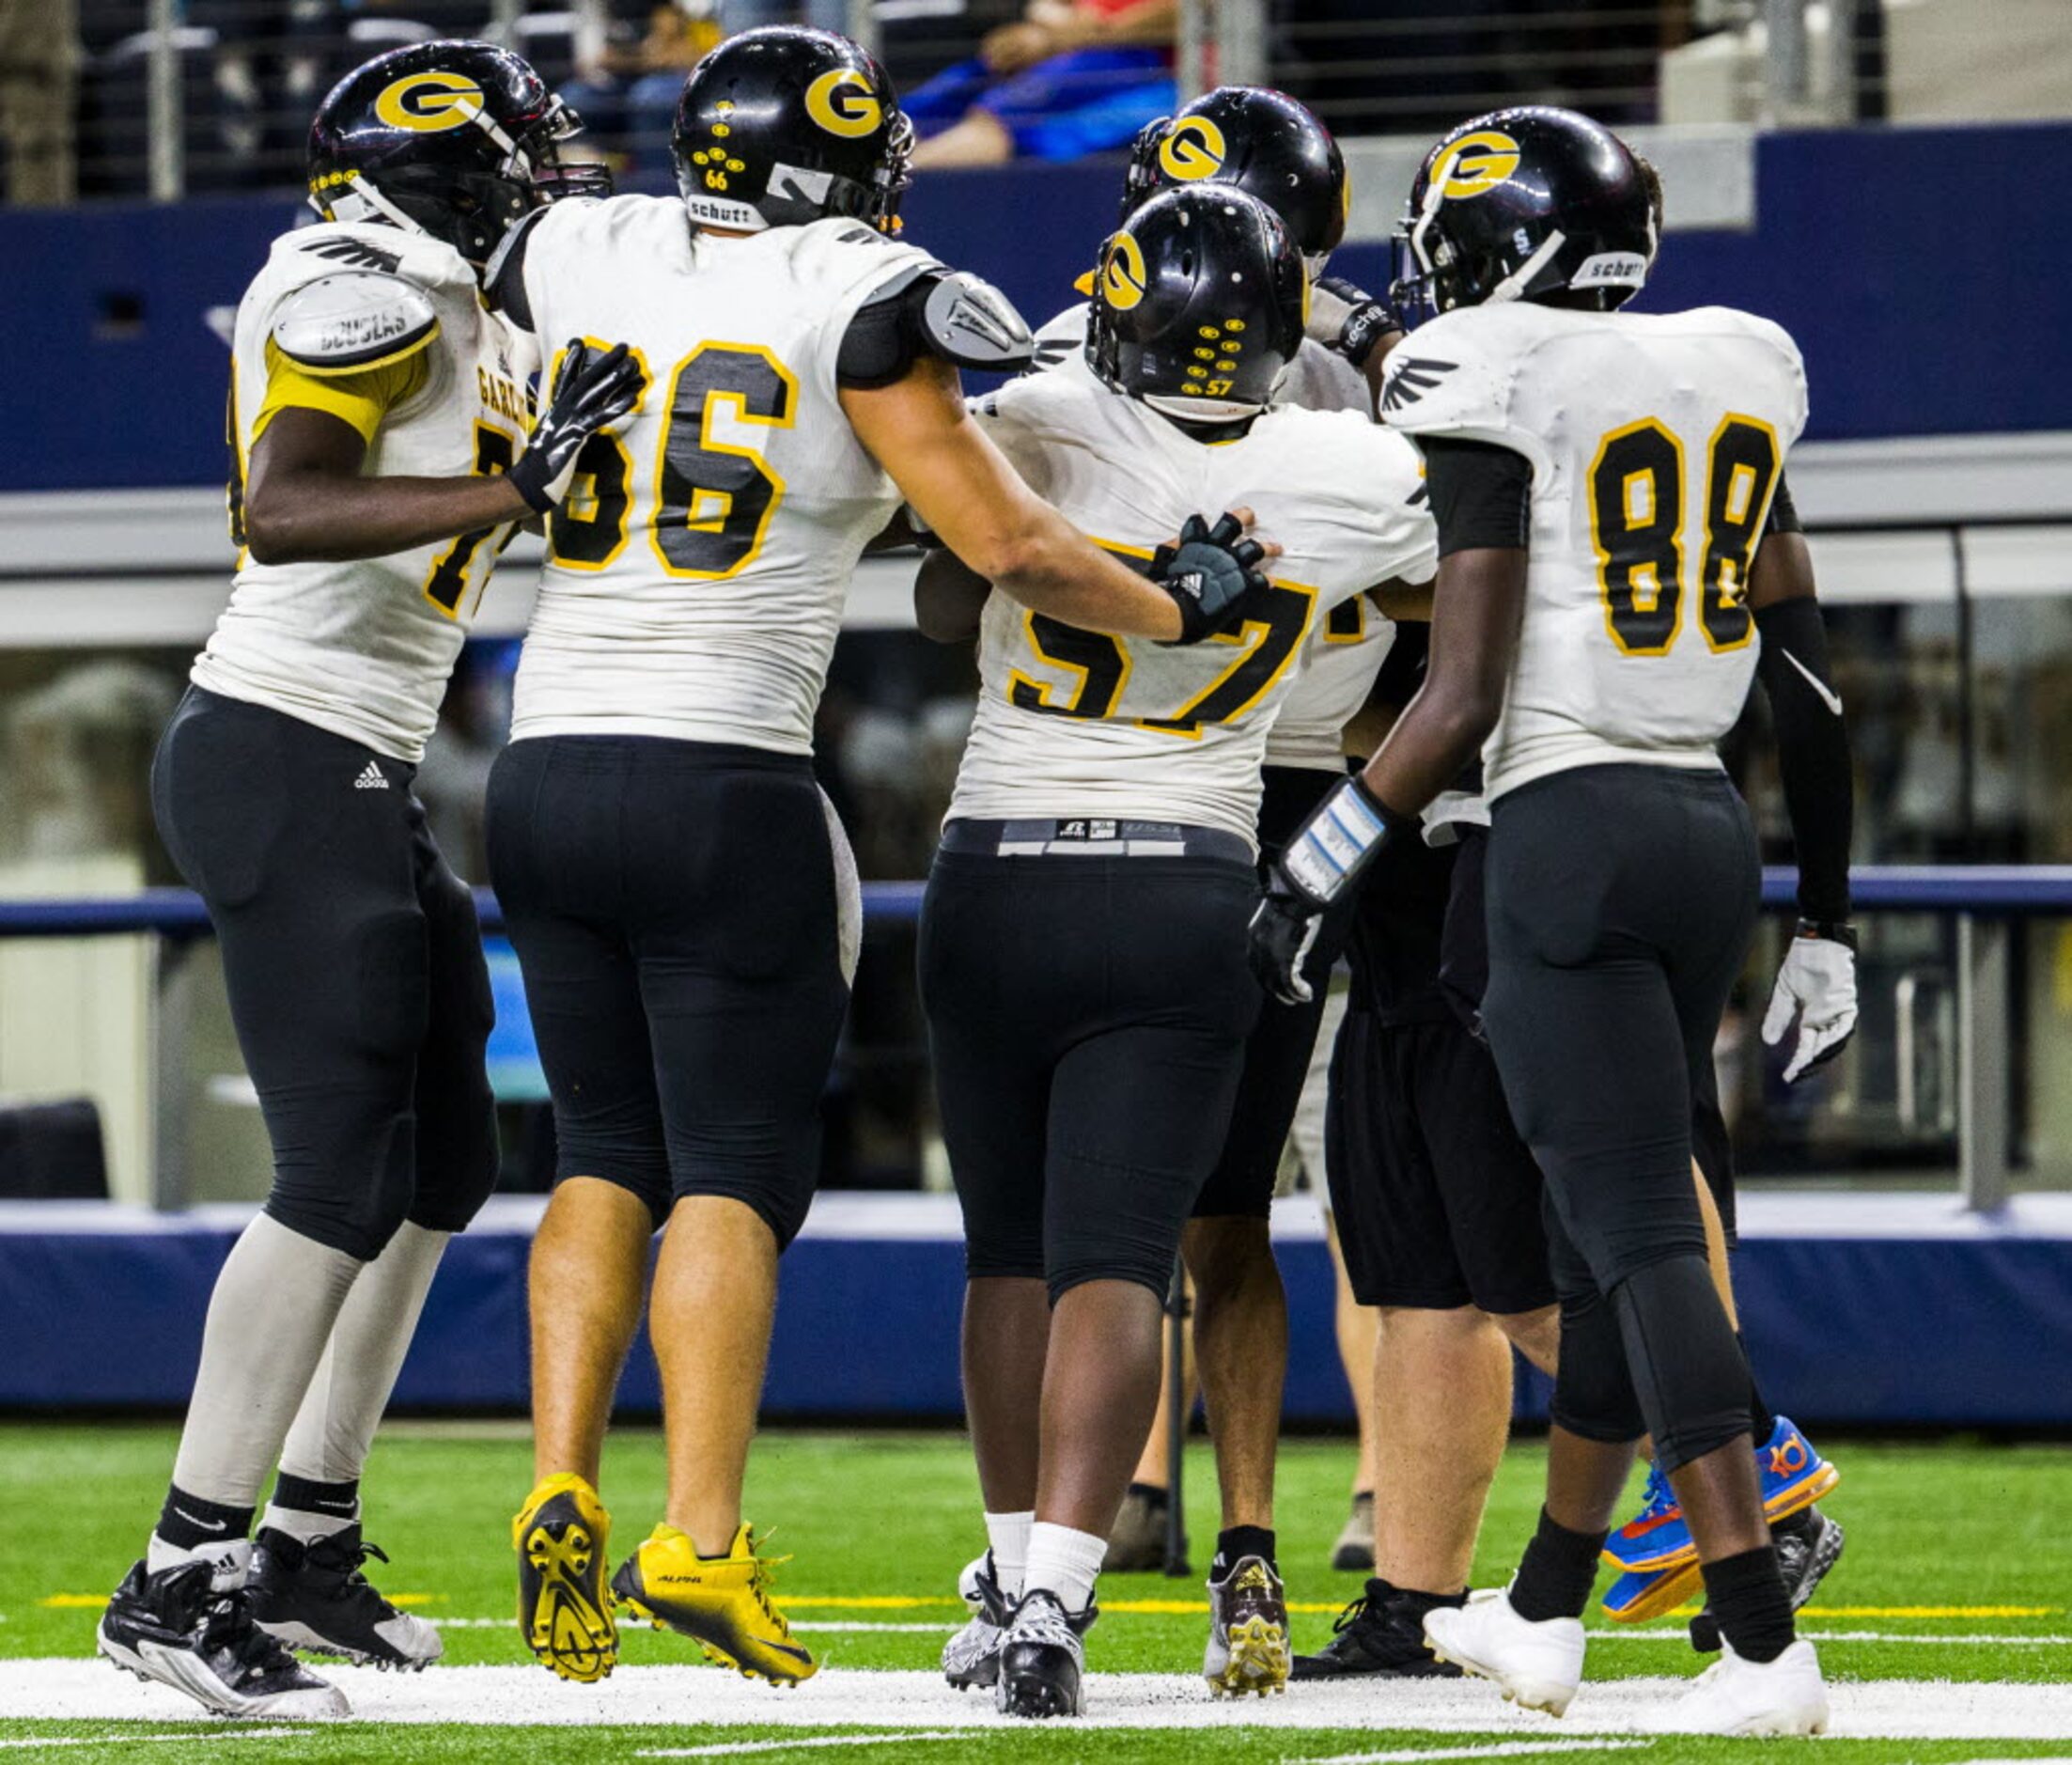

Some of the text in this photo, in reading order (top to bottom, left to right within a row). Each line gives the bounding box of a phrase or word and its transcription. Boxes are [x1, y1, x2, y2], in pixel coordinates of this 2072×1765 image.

[375, 71, 485, 133] G
[805, 68, 883, 138] G
[706, 169, 728, 191] 66
[1160, 116, 1227, 180] G
[1430, 132, 1520, 199] G
[691, 200, 749, 223] schutt
[1206, 379, 1235, 396] 57
[540, 335, 800, 580] 66
[1586, 411, 1782, 657] 88
[1005, 536, 1320, 741] 57
